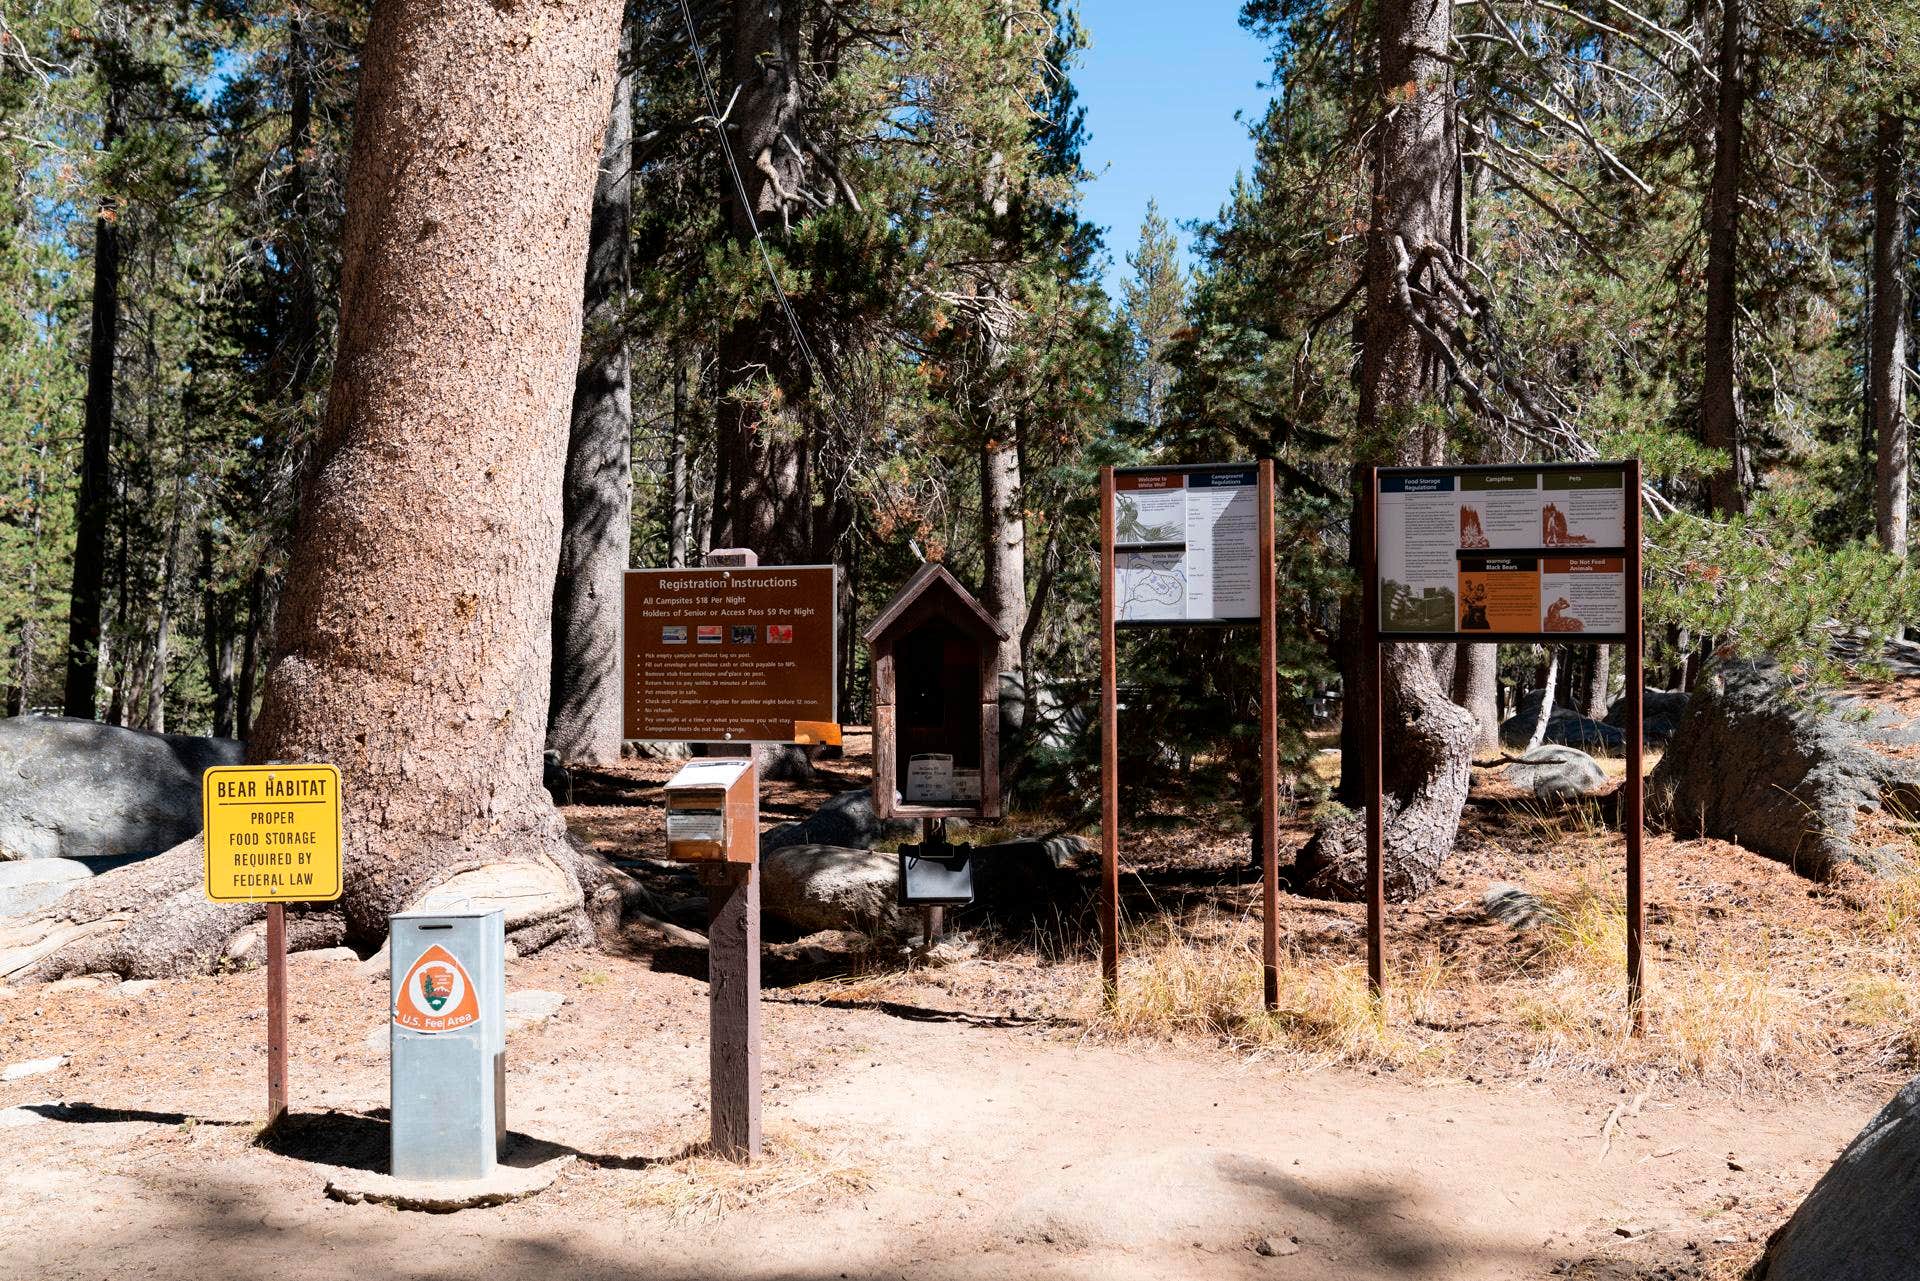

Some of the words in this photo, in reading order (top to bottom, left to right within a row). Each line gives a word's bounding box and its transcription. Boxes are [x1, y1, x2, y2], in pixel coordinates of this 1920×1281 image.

[659, 578, 727, 591] Registration
[731, 577, 798, 589] Instructions
[643, 597, 653, 605] All
[656, 597, 693, 606] Campsites
[695, 596, 708, 605] $18
[725, 596, 746, 606] Night
[767, 608, 776, 616] $9
[794, 607, 815, 617] Night
[218, 781, 256, 798] BEAR
[265, 780, 326, 796] HABITAT
[251, 812, 295, 824] PROPER
[229, 833, 259, 846] FOOD
[265, 832, 316, 845] STORAGE
[234, 853, 292, 867] REQUIRED
[298, 852, 312, 865] BY
[233, 874, 285, 886] FEDERAL
[290, 873, 313, 885] LAW
[402, 1014, 421, 1026] U.S.
[447, 1013, 472, 1026] Area
